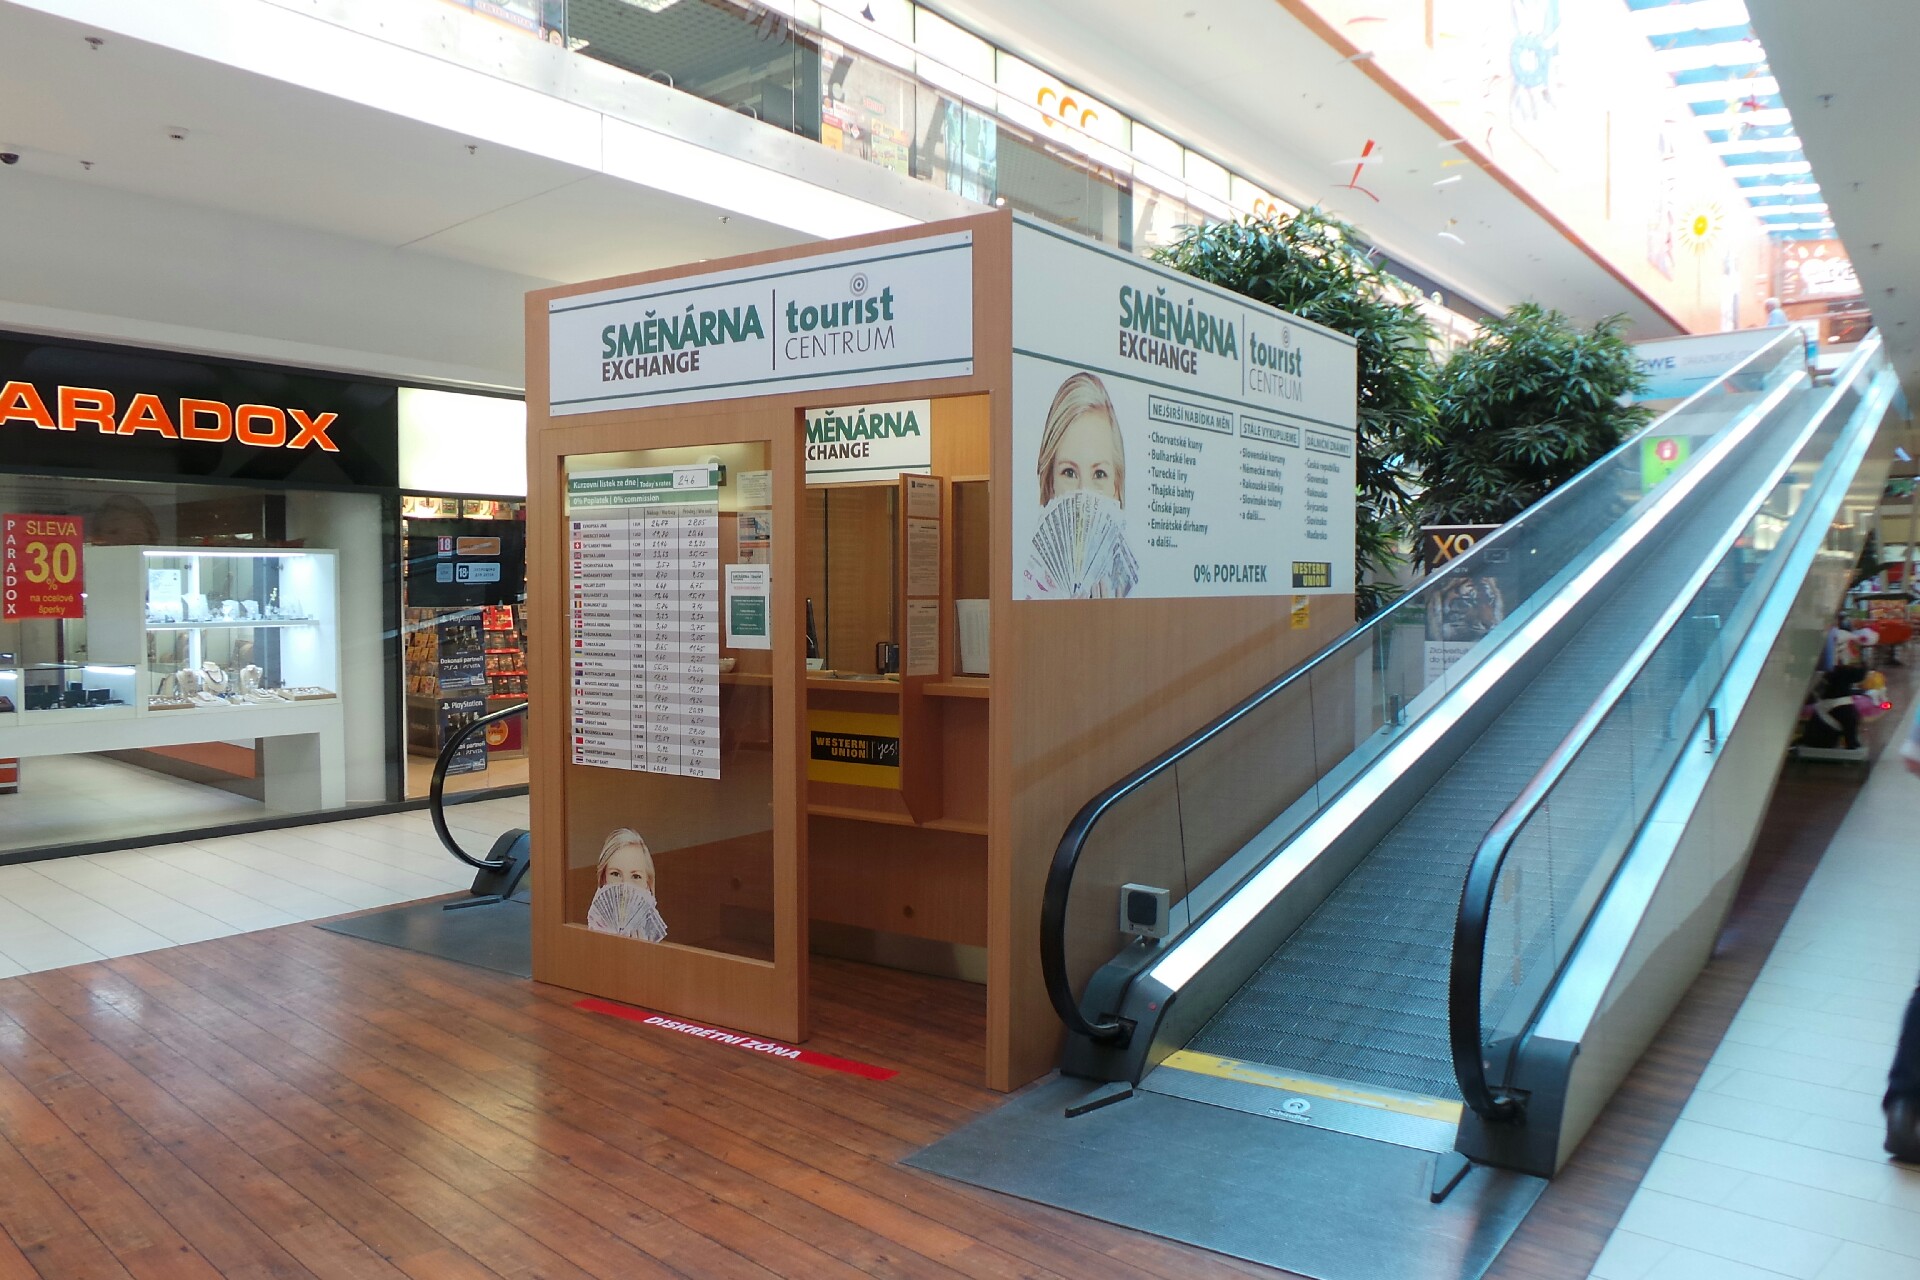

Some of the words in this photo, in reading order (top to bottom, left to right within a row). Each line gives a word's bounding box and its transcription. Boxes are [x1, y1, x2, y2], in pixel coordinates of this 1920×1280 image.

[602, 304, 765, 360] SMĚNÁRNA
[786, 285, 894, 334] tourist
[1119, 284, 1239, 361] SMĚNÁRNA
[1250, 331, 1302, 377] tourist
[602, 350, 700, 382] EXCHANGE
[785, 325, 895, 360] CENTRUM
[1119, 329, 1197, 375] EXCHANGE
[1250, 368, 1303, 402] CENTRUM
[0, 380, 340, 452] ARADOX
[1152, 403, 1184, 421] NEJŠIRŠÍ
[1184, 409, 1215, 427] NABÍDKA
[805, 407, 920, 444] MĚNÁRNA
[805, 442, 870, 461] CHANGE
[1152, 432, 1186, 448] Chorvatské
[1187, 439, 1203, 453] kuny
[1152, 449, 1183, 464] Bulharské
[1184, 455, 1197, 466] leva
[573, 480, 599, 489] Kurzovní
[624, 478, 637, 486] dne
[1152, 466, 1176, 480] Turecké
[1177, 470, 1188, 483] liry
[583, 496, 609, 504] Poplatek
[613, 495, 623, 503] 0%
[624, 494, 660, 503] commission
[1152, 483, 1176, 498] Thajské
[1151, 499, 1172, 513] Čínské
[1173, 503, 1191, 518] juany
[26, 520, 77, 536] SLEVA
[439, 538, 451, 551] 18
[5, 520, 17, 614] PARADOX
[25, 541, 77, 584] 30
[1293, 563, 1326, 574] WESTERN
[1193, 564, 1212, 583] 0%
[1213, 564, 1267, 583] POPLATEK
[1302, 574, 1326, 586] UNION
[45, 578, 58, 591] %
[30, 594, 40, 602] na
[42, 593, 74, 602] ocelové
[38, 605, 66, 615] šperky
[451, 699, 484, 710] PlayStation
[815, 736, 866, 749] WESTERN
[831, 747, 866, 759] UNION
[877, 740, 898, 760] yes!
[643, 1016, 749, 1046] DISKRÉTNÍ
[741, 1040, 802, 1060] ZÓNA
